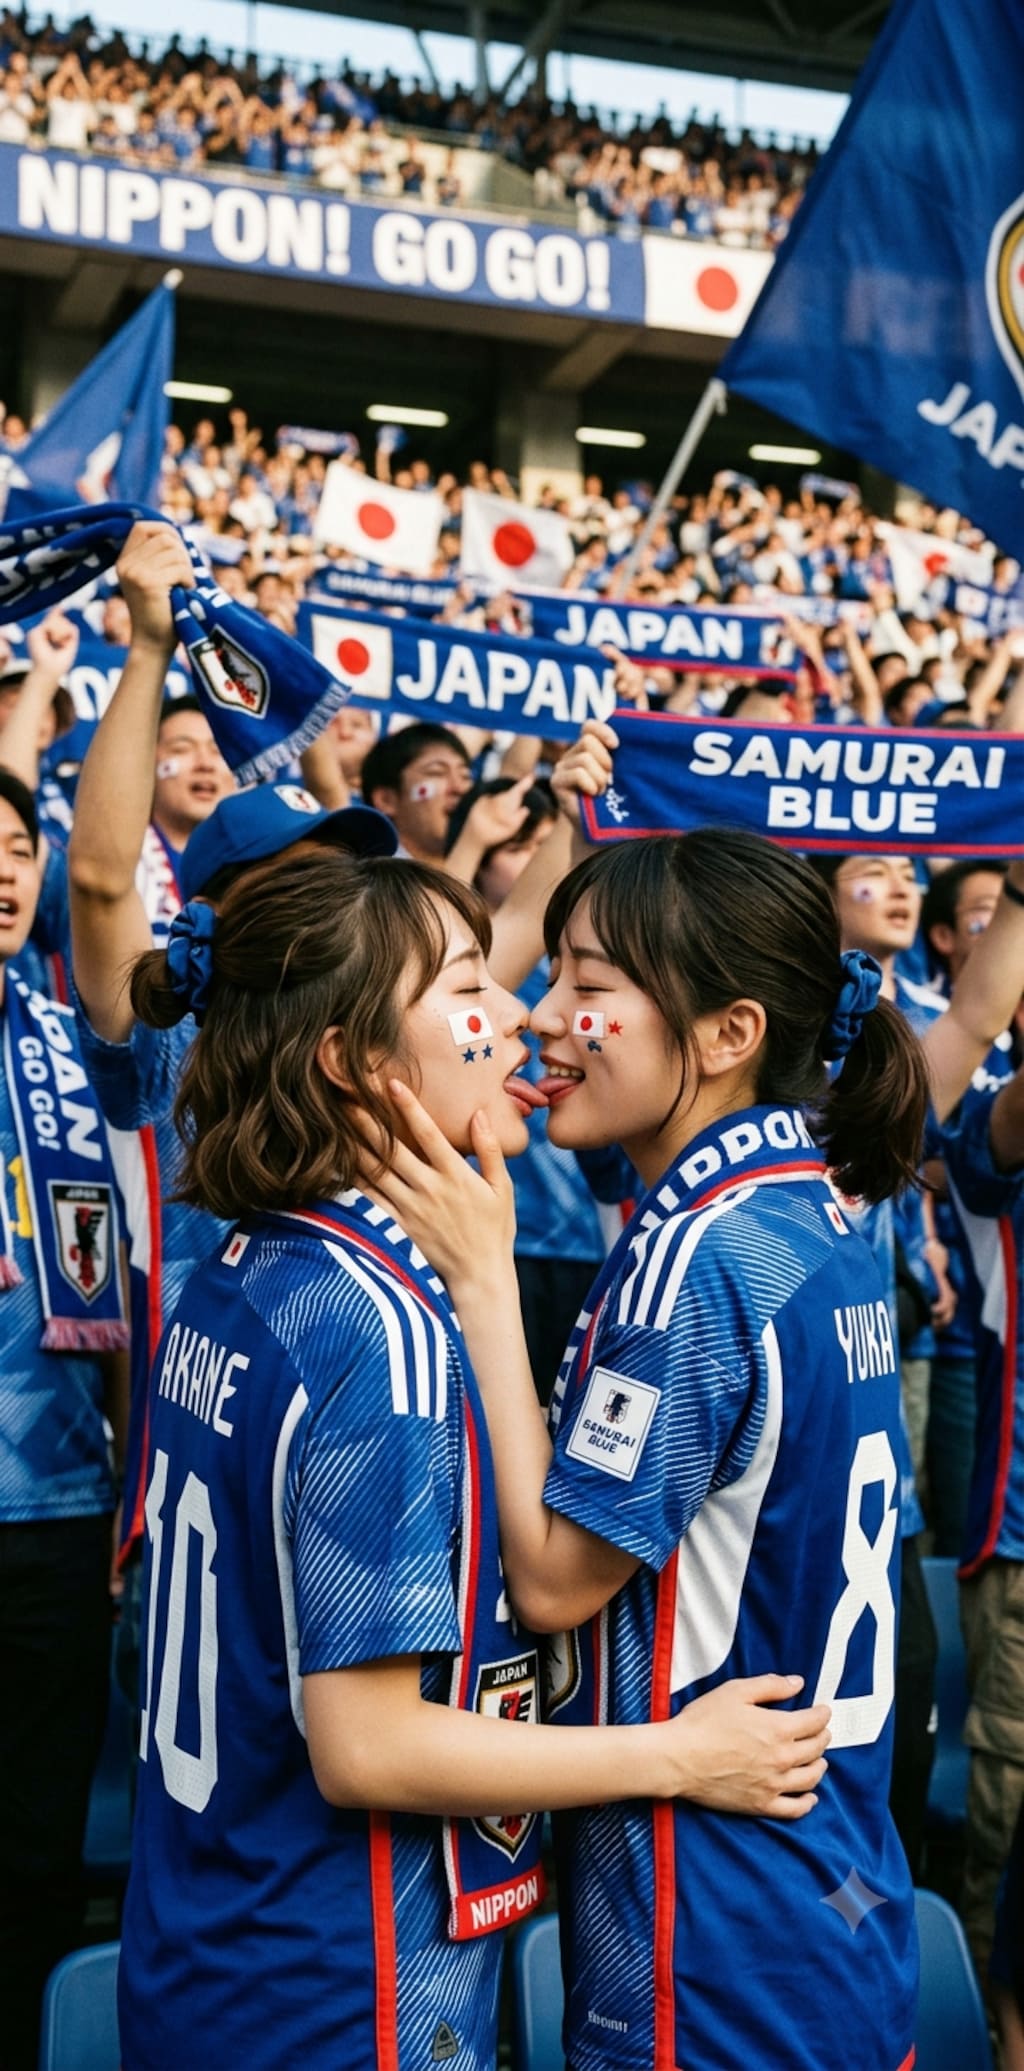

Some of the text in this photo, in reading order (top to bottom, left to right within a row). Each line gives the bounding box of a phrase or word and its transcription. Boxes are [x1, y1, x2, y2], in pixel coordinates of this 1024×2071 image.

[18, 153, 610, 312] NIPPON! GO GO!
[916, 381, 1024, 472] JAP
[554, 605, 743, 660] JAPAN
[396, 639, 617, 723] JAPAN
[689, 732, 1006, 789] SAMURAI
[767, 786, 938, 834] BLUE
[18, 1035, 61, 1151] GO GO!
[159, 1322, 250, 1438] AKANE
[834, 1300, 896, 1384] YUKA
[139, 1448, 218, 1813] 10
[813, 1430, 898, 1750] 8
[492, 1662, 528, 1685] JAPAN
[470, 1876, 539, 1930] NIPPON
